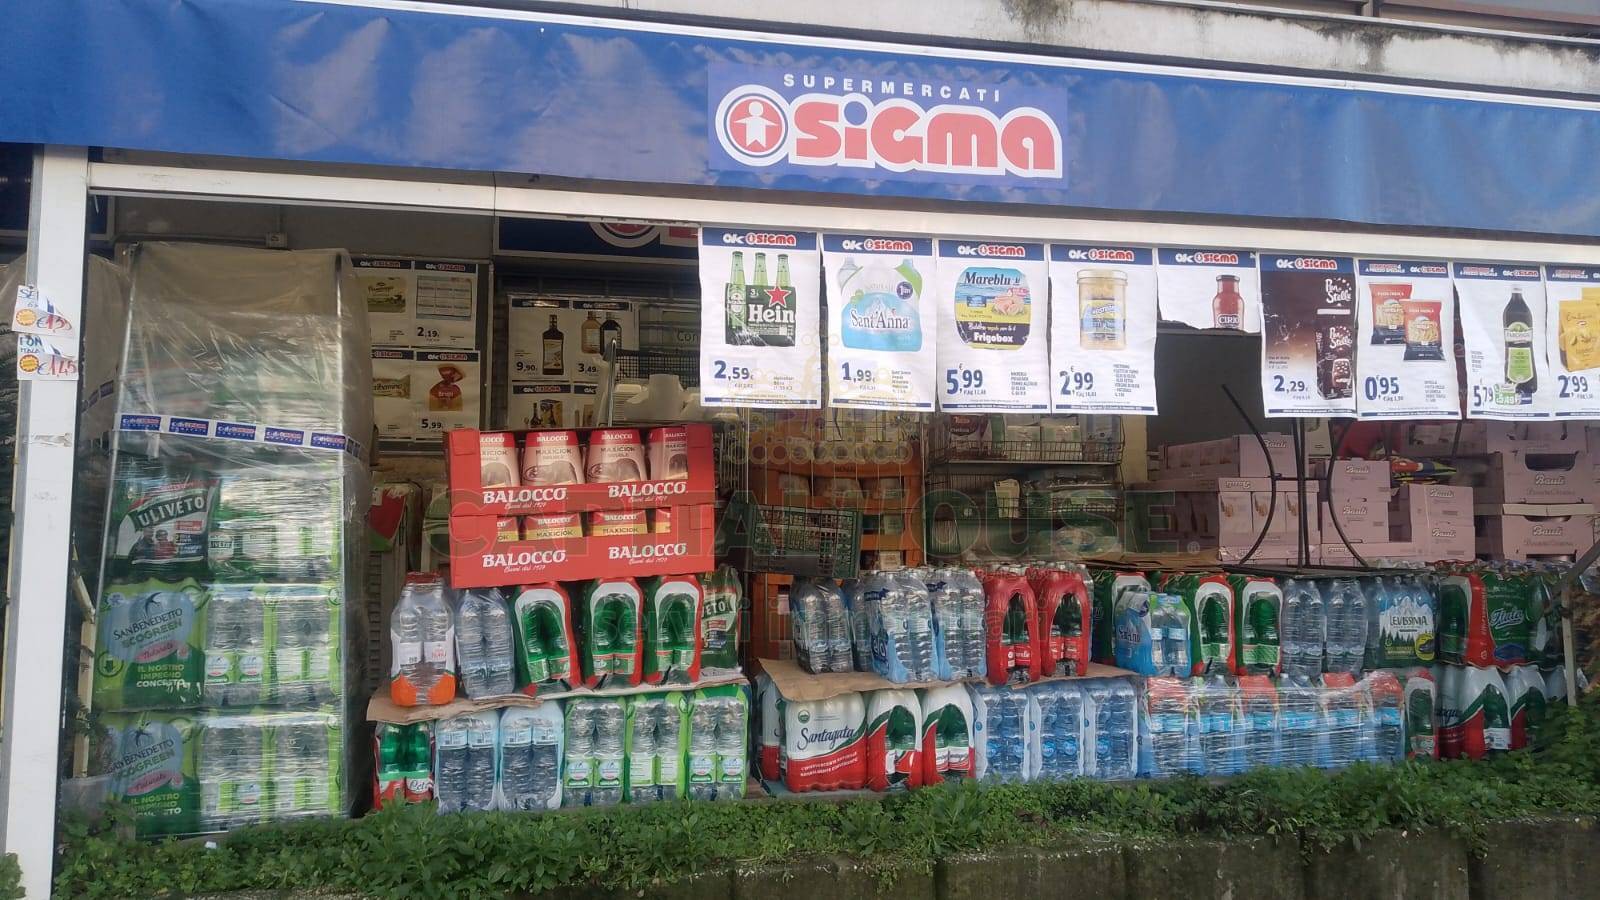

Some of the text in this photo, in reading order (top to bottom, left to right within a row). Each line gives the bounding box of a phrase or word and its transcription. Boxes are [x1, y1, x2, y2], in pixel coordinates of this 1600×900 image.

[783, 73, 999, 102] SUPERMERCATI
[965, 272, 1011, 286] Mareblu
[748, 304, 795, 323] Hein
[851, 309, 909, 329] Sant'Anna
[974, 332, 1014, 344] Frigobox
[536, 435, 569, 443] BALOCCO
[601, 432, 633, 441] BALOCCO
[482, 487, 568, 504] BALOCCO
[608, 481, 687, 498] BALOCCO
[137, 496, 205, 528] ULIVETO
[537, 516, 572, 525] BALOCCO
[604, 513, 638, 521] BALOCCO
[482, 549, 567, 568] BALOCCO
[608, 543, 687, 560] BALOCCO
[797, 724, 856, 751] Santagata
